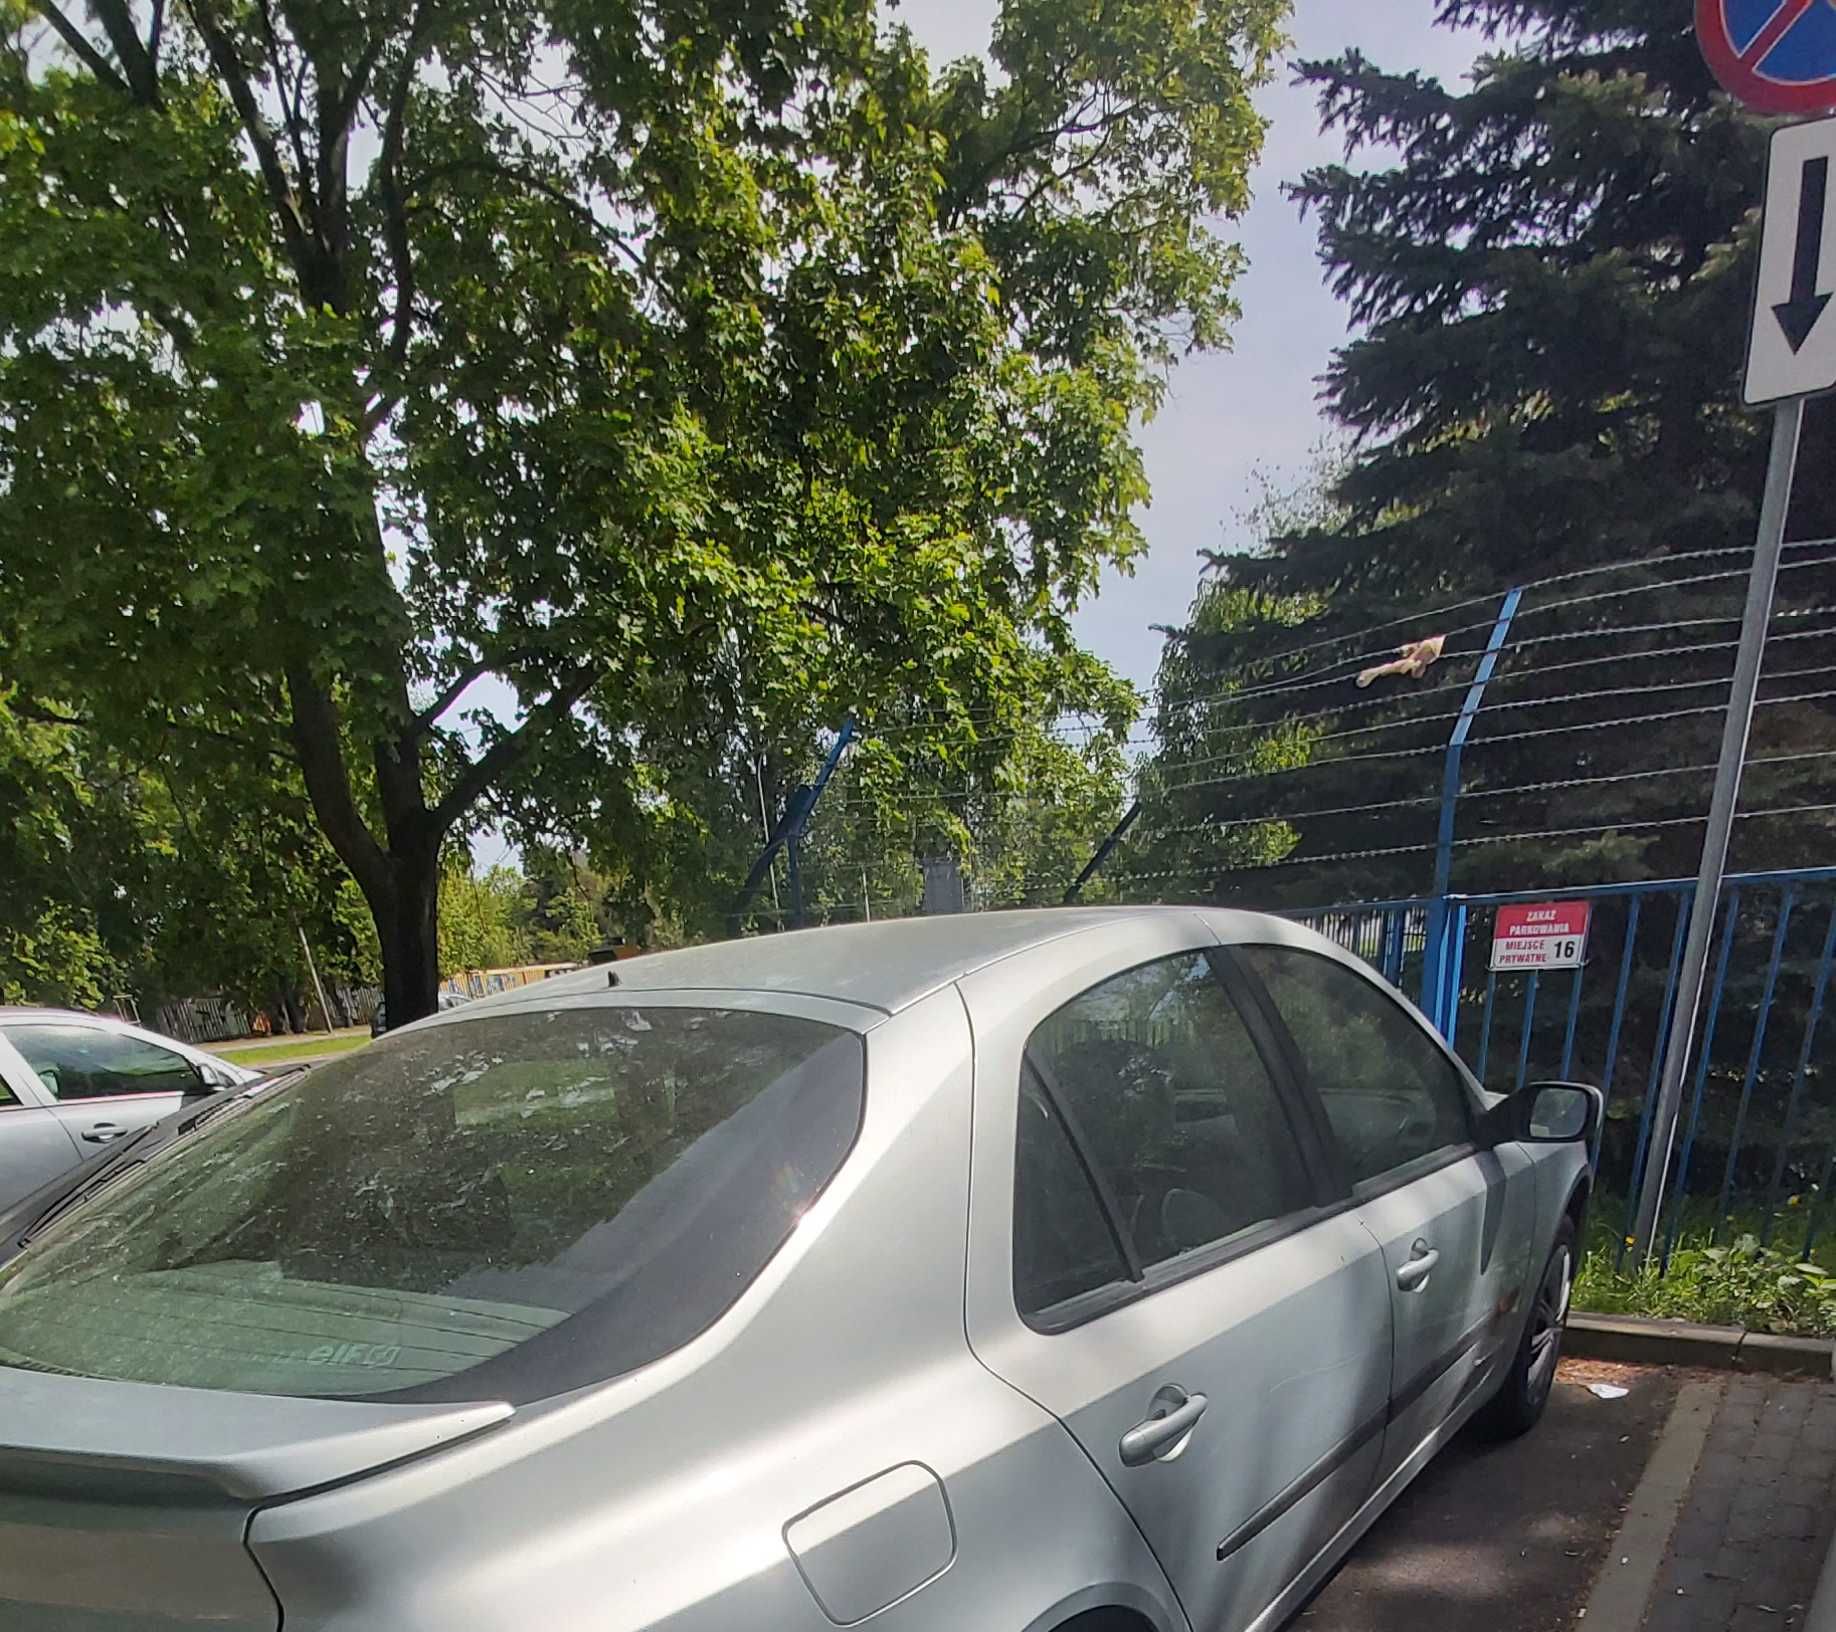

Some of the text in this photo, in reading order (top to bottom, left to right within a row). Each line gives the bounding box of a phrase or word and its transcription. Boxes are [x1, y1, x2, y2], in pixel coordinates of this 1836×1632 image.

[1526, 910, 1557, 921] ZAKAZ
[1509, 923, 1569, 936] PARKOWANIA
[1505, 940, 1545, 951] MIEJSCE
[1554, 941, 1575, 959] 16
[1500, 954, 1547, 963] PRYWATNE
